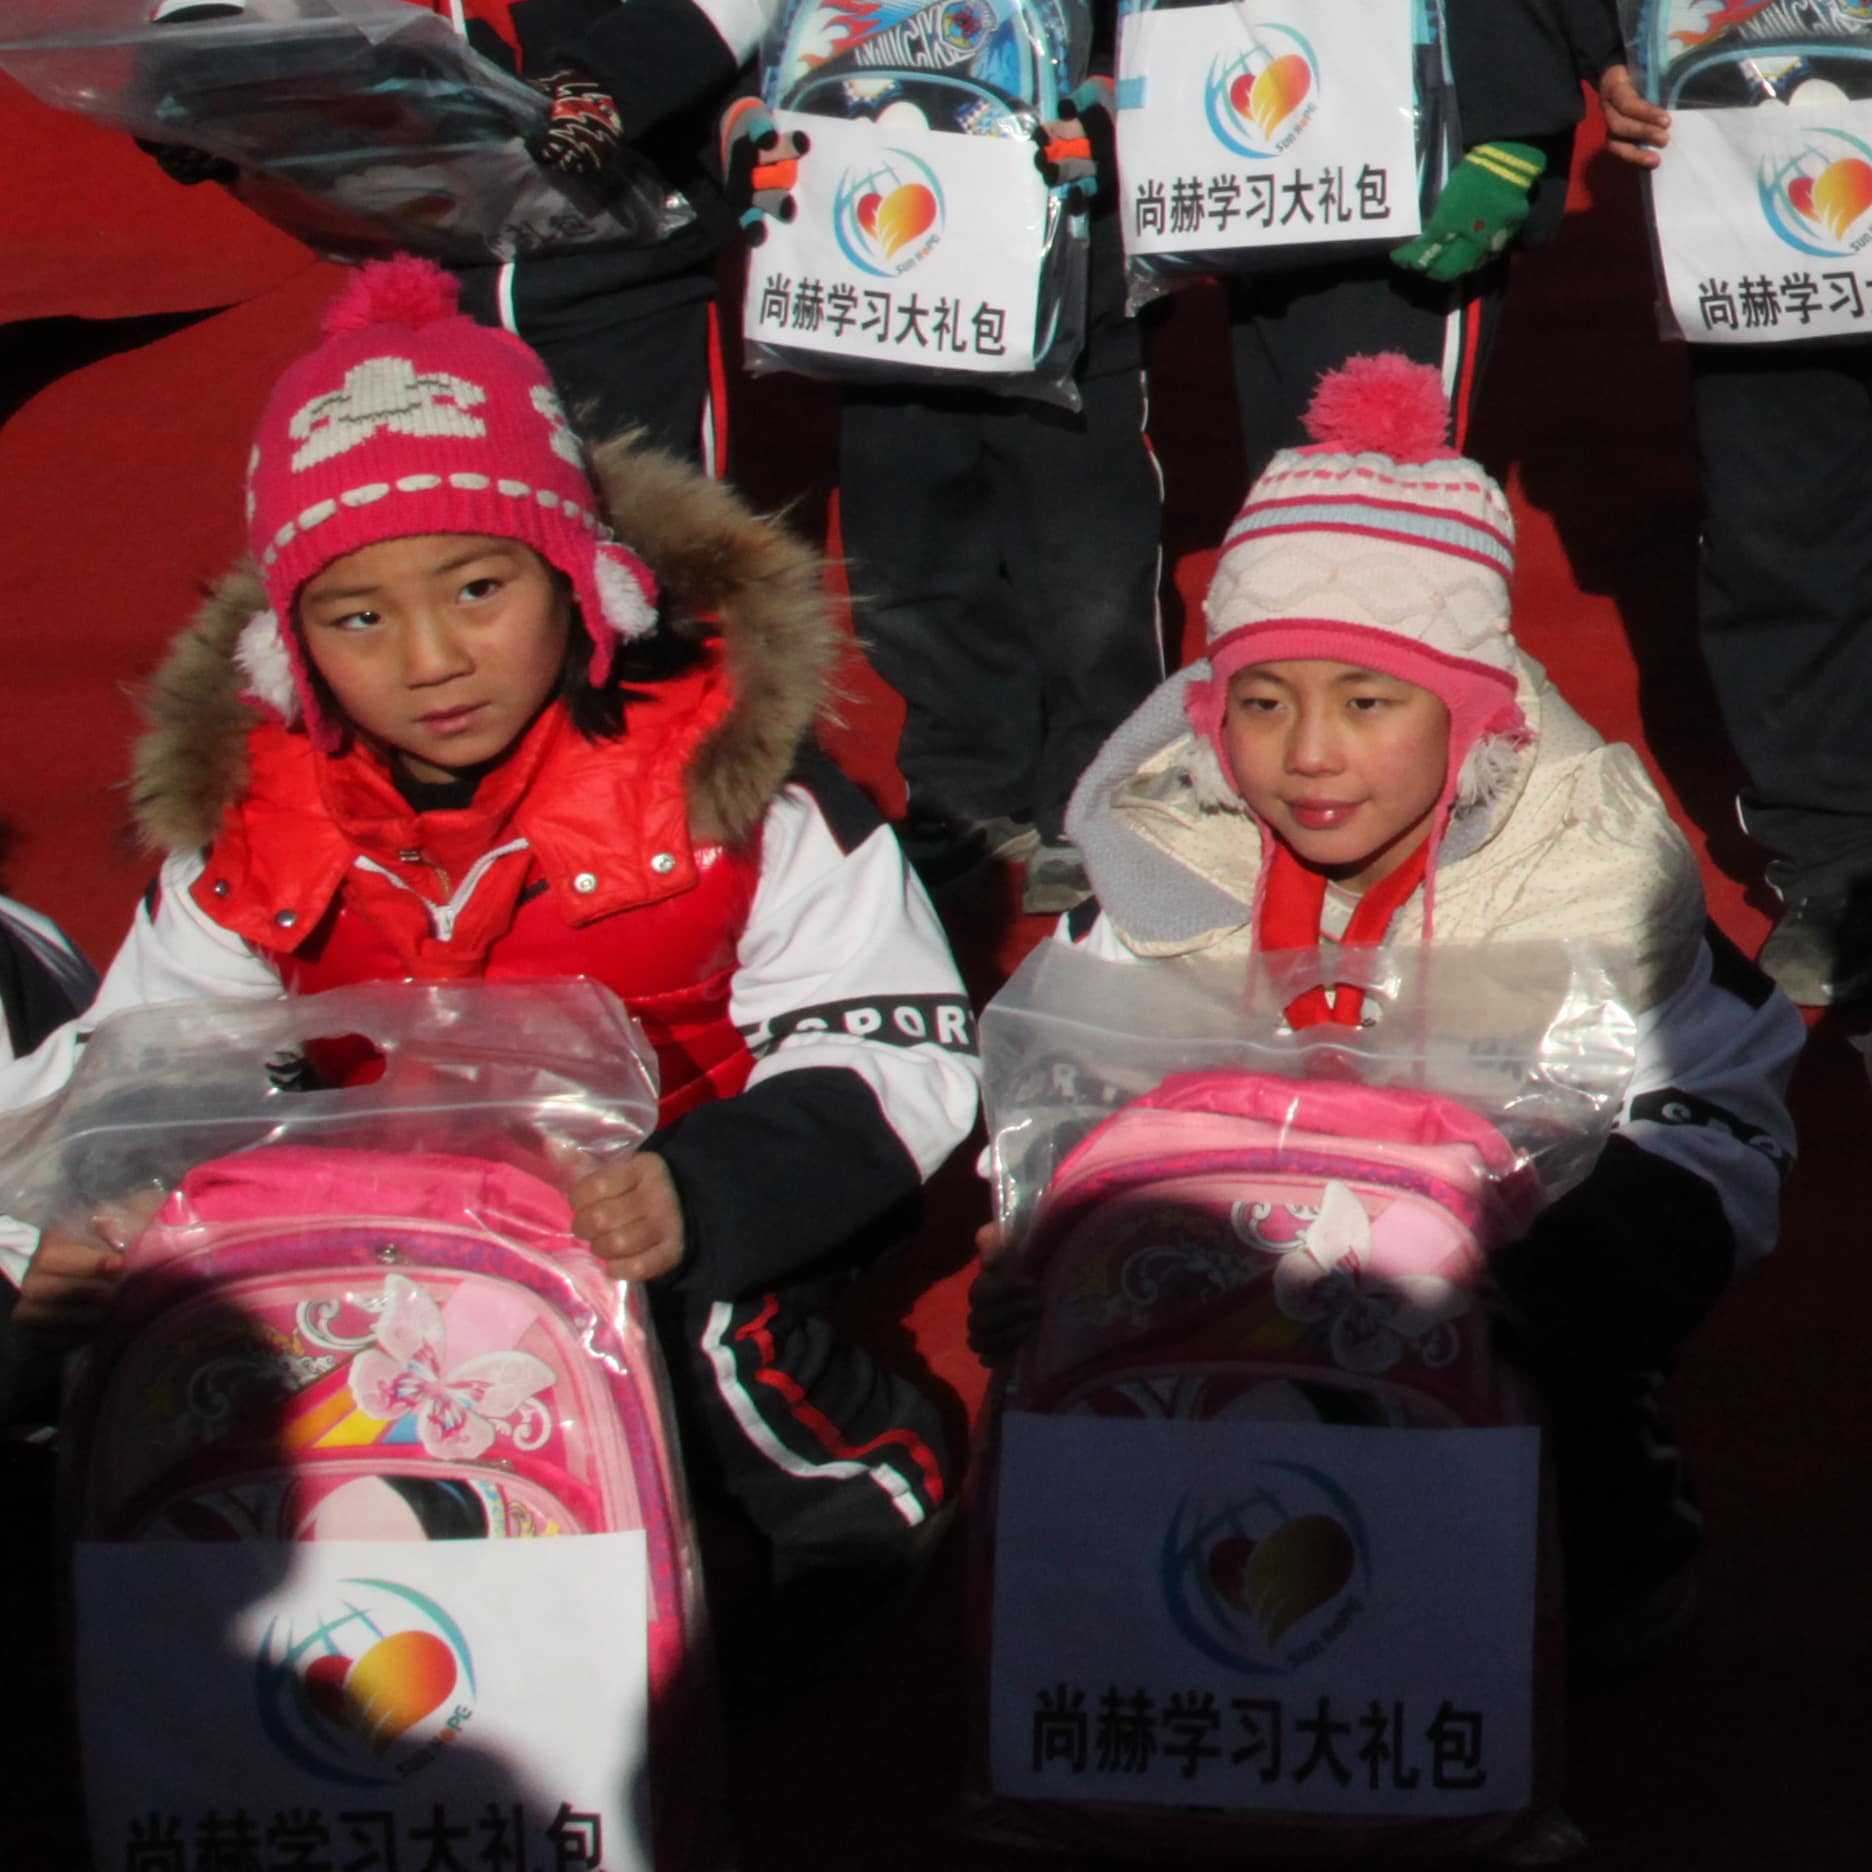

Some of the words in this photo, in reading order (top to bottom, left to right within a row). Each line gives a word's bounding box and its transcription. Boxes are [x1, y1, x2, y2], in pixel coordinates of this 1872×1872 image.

[1136, 163, 1391, 238] 尚赫学习大礼包
[758, 272, 1007, 355] 尚赫学习大礼包
[1030, 1684, 1487, 1791] 尚赫学习大礼包
